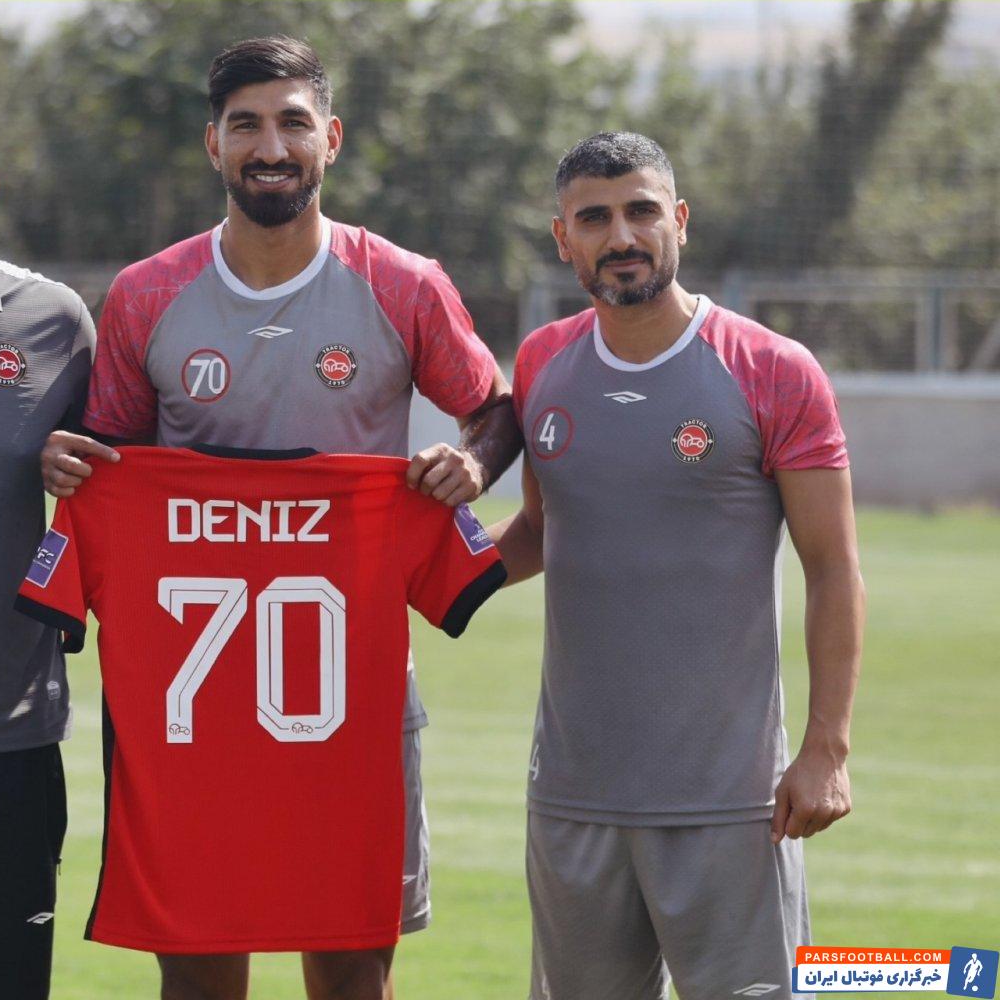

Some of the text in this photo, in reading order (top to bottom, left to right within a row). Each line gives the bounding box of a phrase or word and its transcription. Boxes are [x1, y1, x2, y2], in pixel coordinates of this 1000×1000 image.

[190, 357, 226, 398] 70
[539, 413, 556, 451] 4
[167, 498, 331, 543] DENIZ
[157, 575, 347, 743] 70
